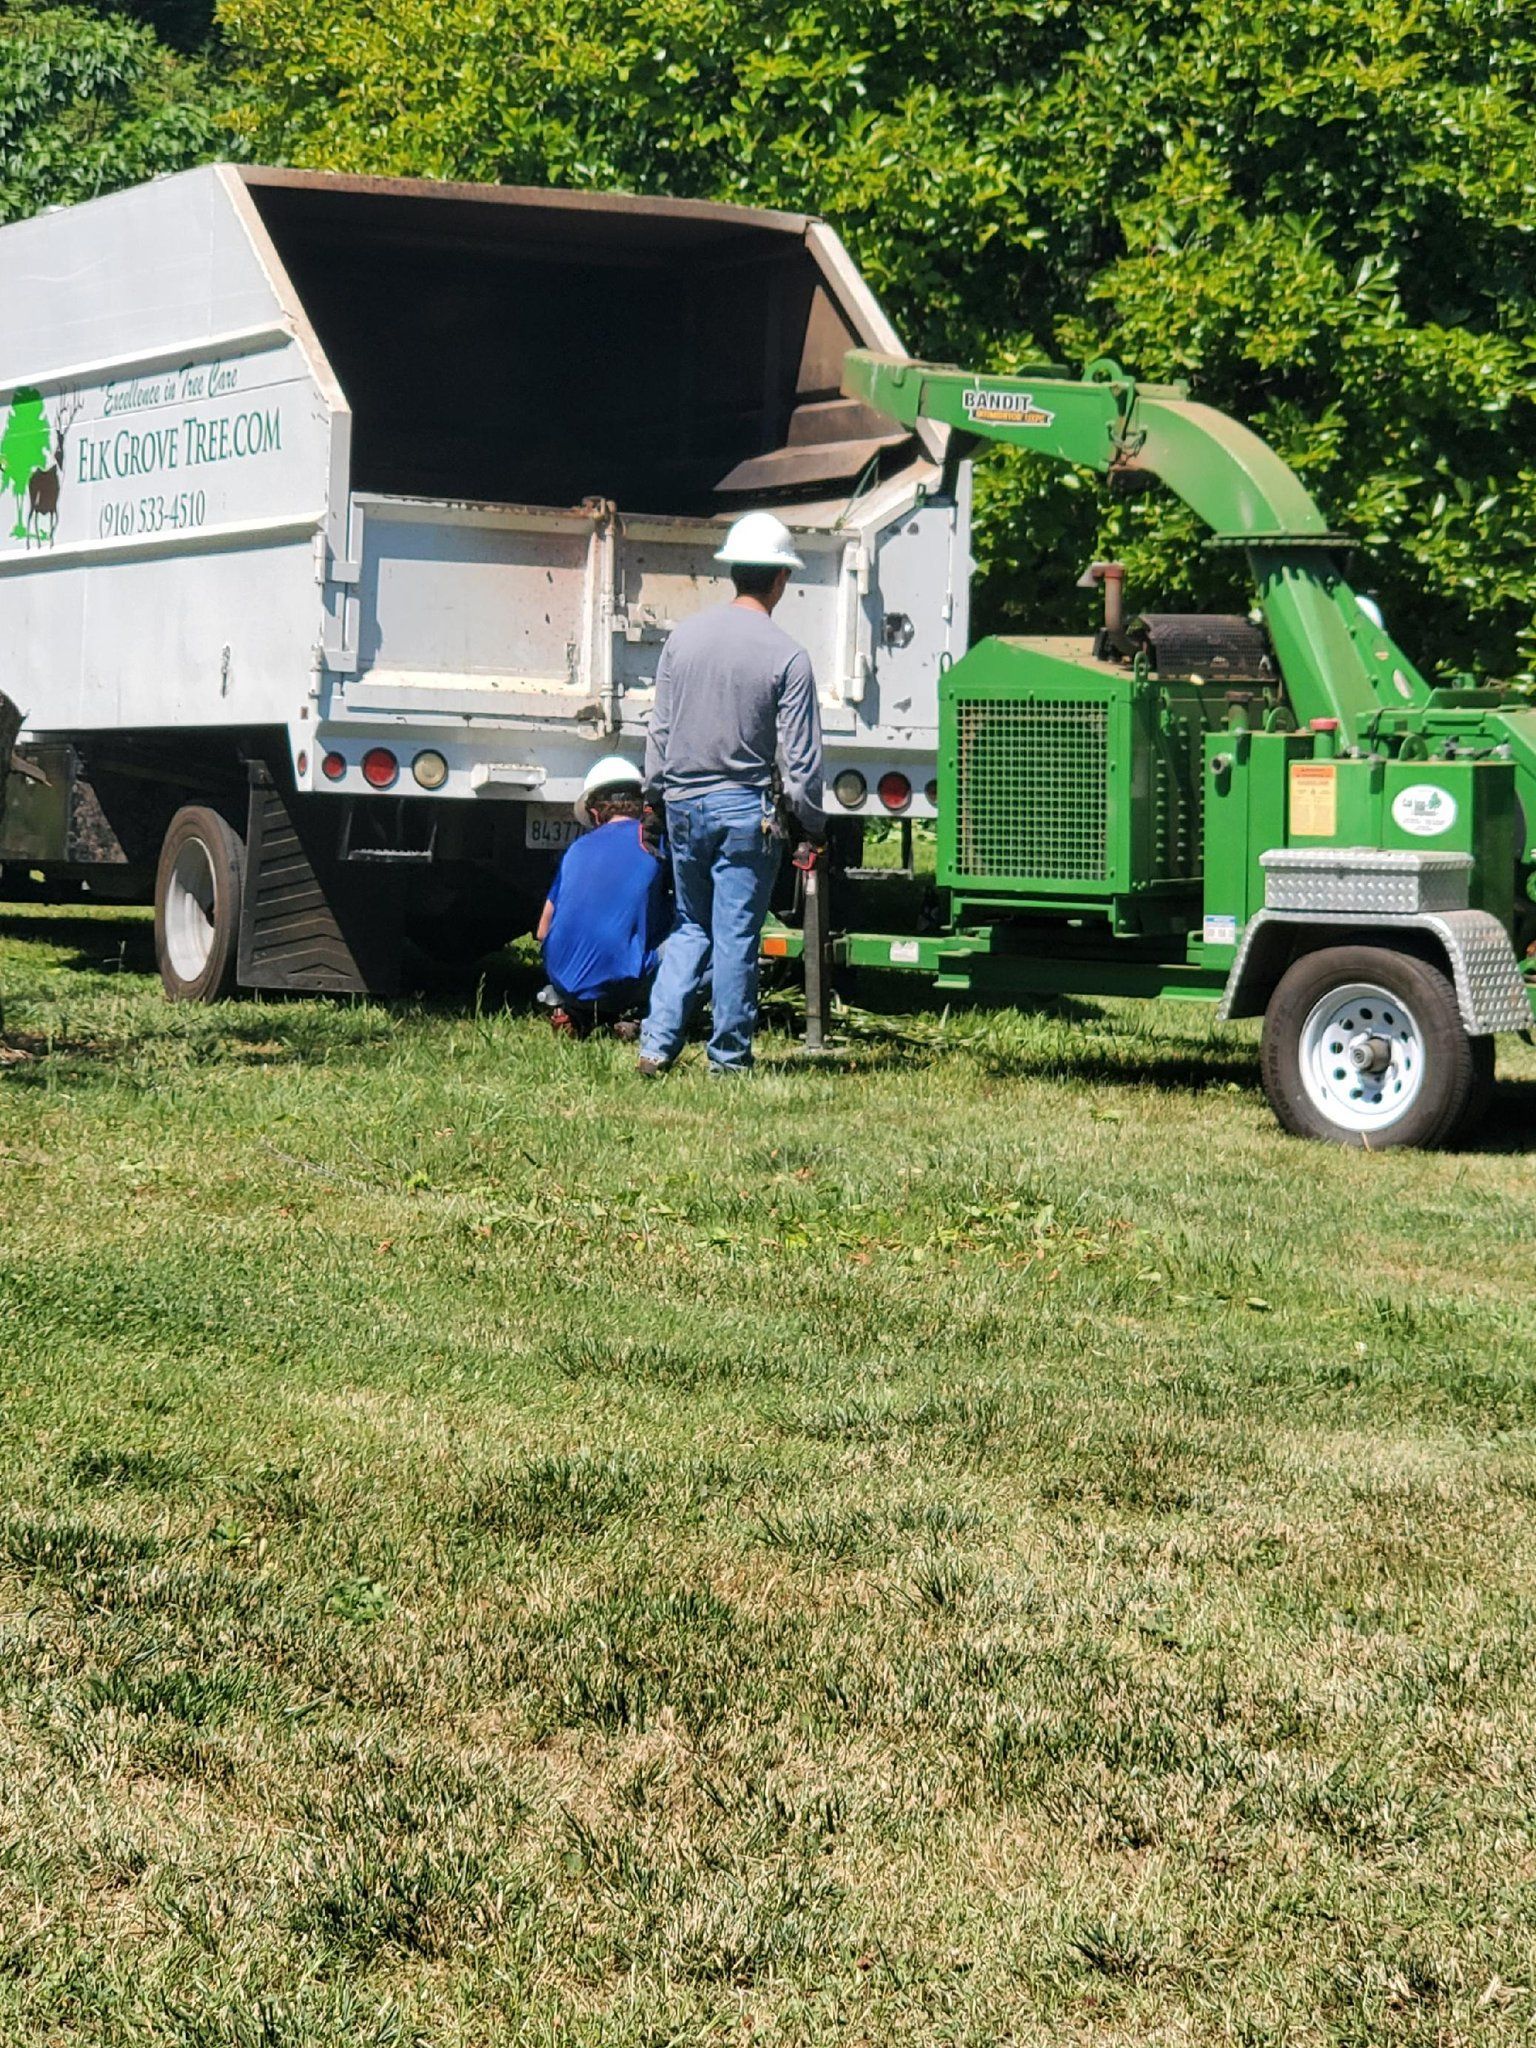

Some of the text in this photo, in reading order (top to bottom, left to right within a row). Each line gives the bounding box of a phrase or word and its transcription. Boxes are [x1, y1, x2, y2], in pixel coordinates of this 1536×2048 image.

[102, 359, 238, 416] Excellence in Tree Care
[964, 392, 1031, 411] BANDIT
[99, 490, 206, 539] (916) 533-4510
